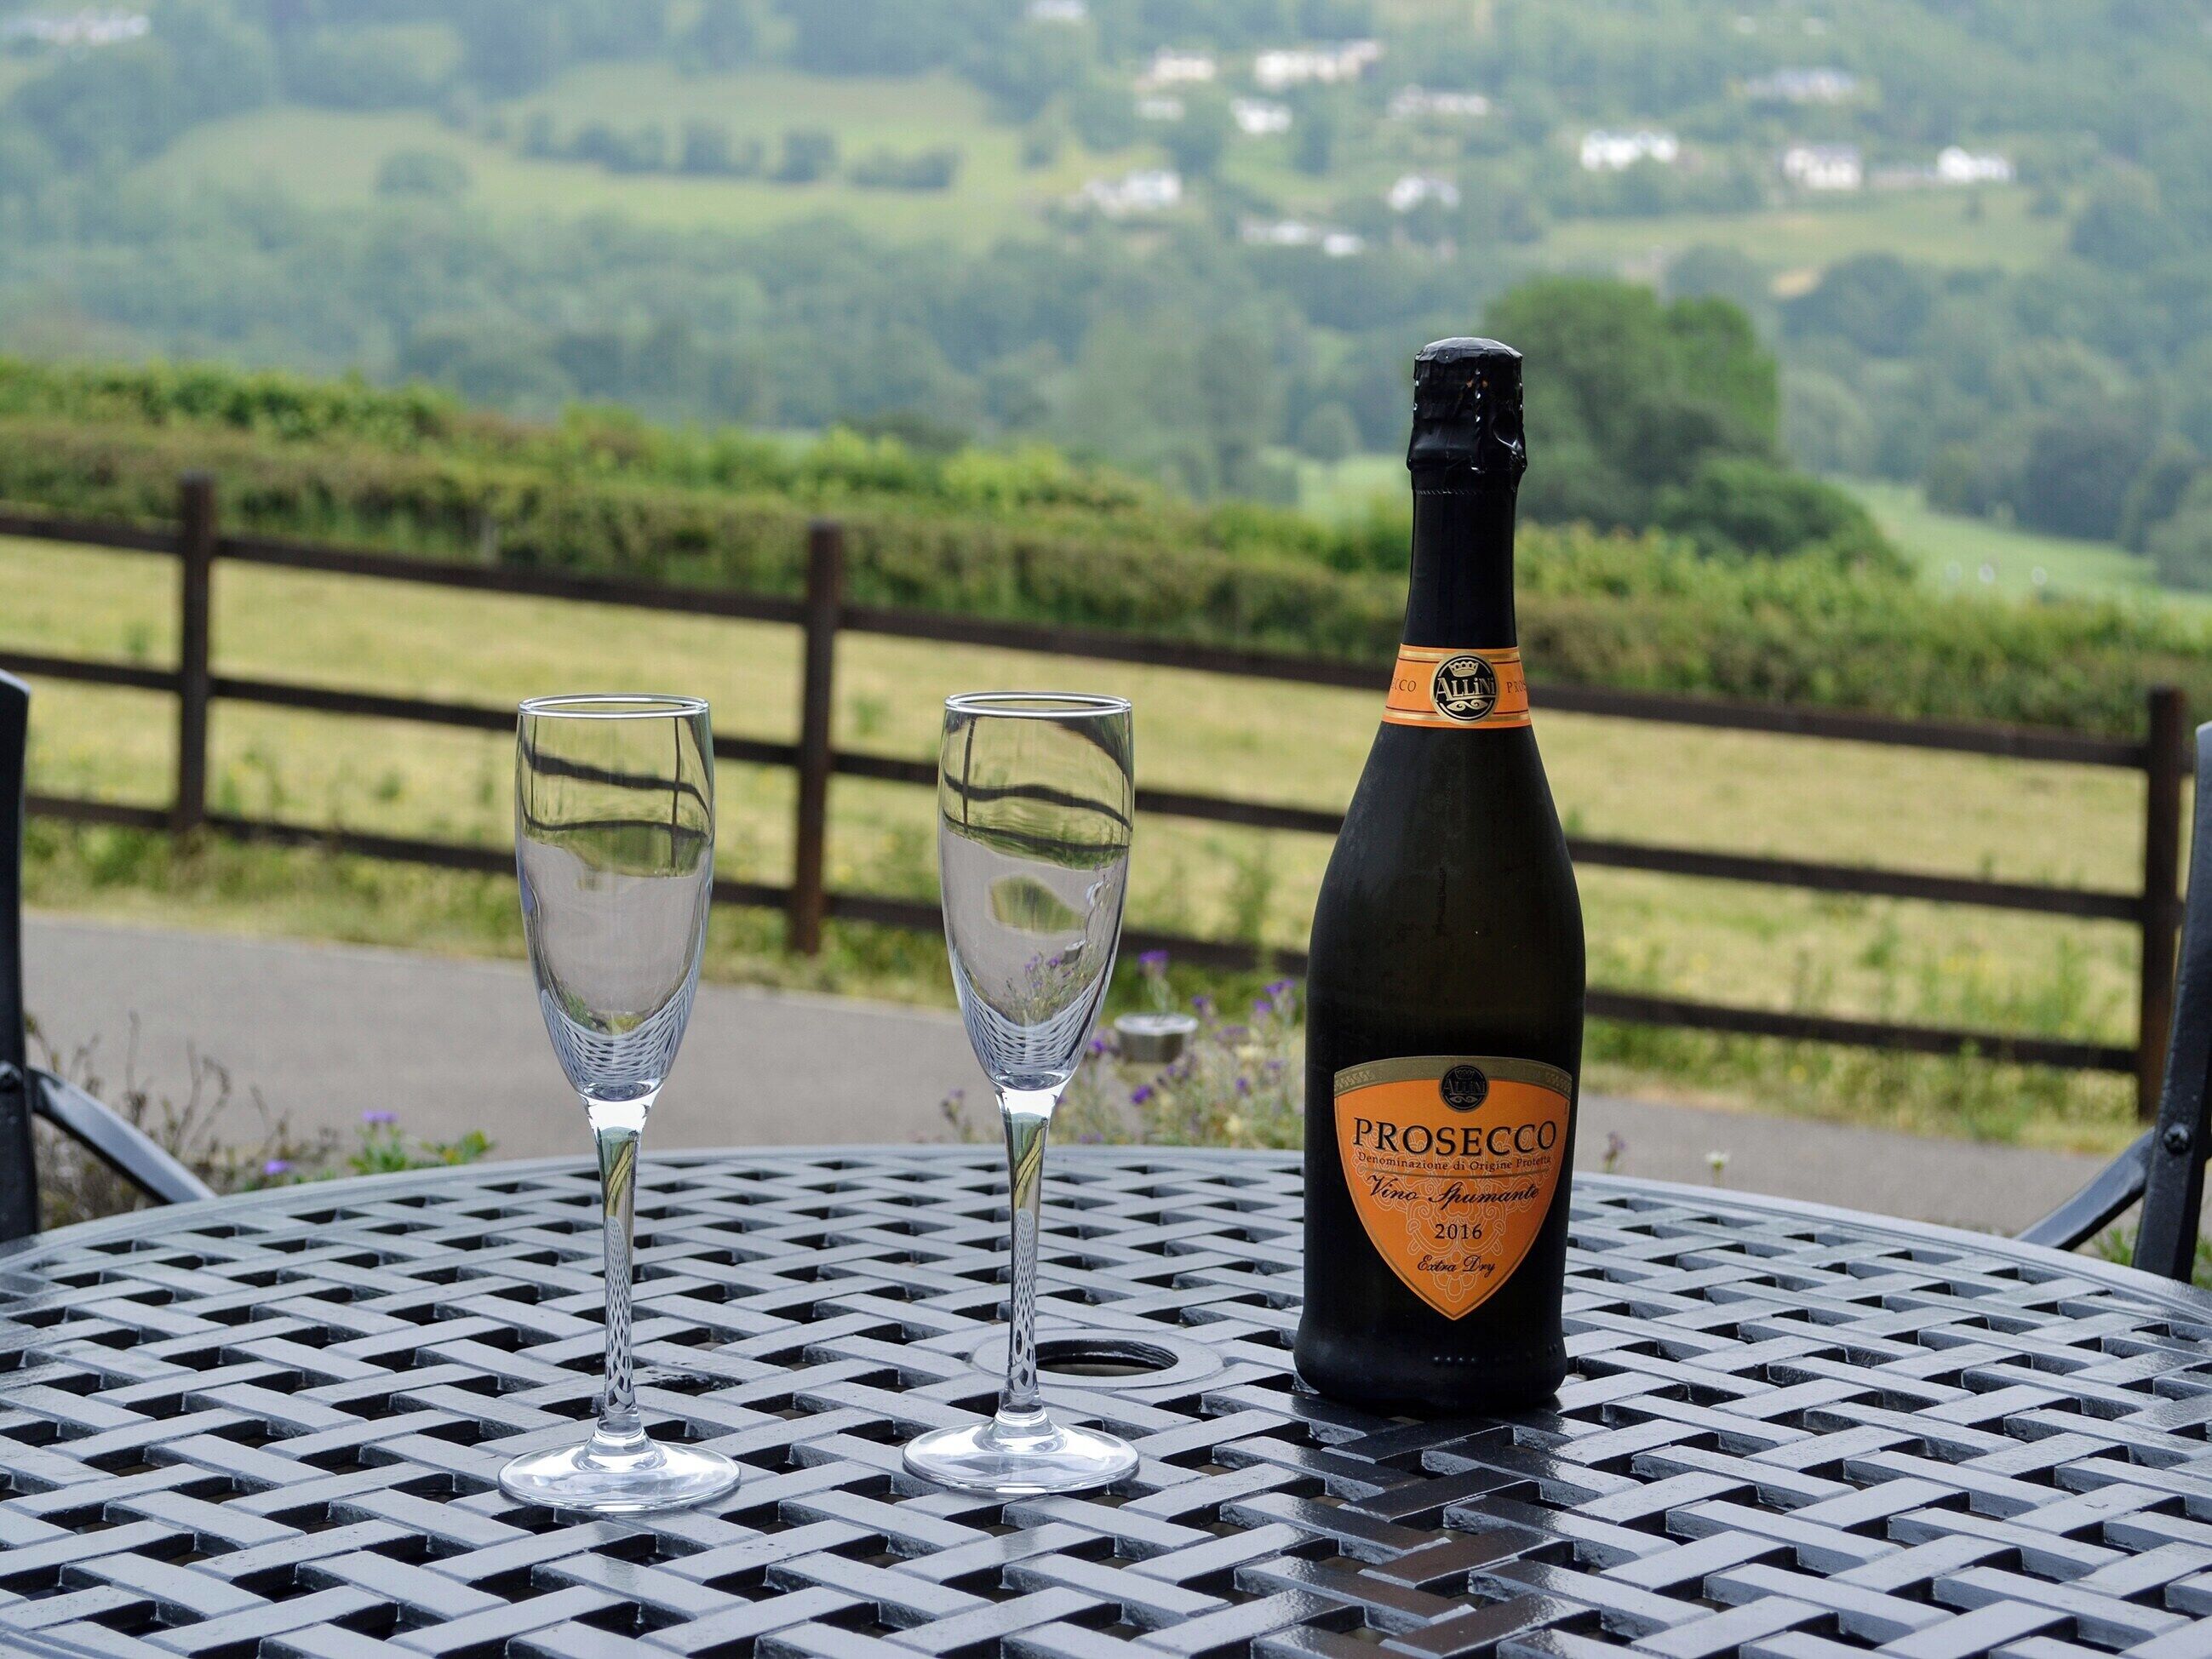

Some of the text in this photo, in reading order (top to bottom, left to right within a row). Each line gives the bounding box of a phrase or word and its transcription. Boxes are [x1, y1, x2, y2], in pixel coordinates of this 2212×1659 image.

[1353, 1118, 1556, 1156] PROSECCO
[1358, 1152, 1550, 1173] Denominazione di Origine Protetta
[1367, 1175, 1539, 1210] Vino Spumante
[1435, 1224, 1482, 1239] 2016
[1417, 1254, 1496, 1279] Extra Dry
